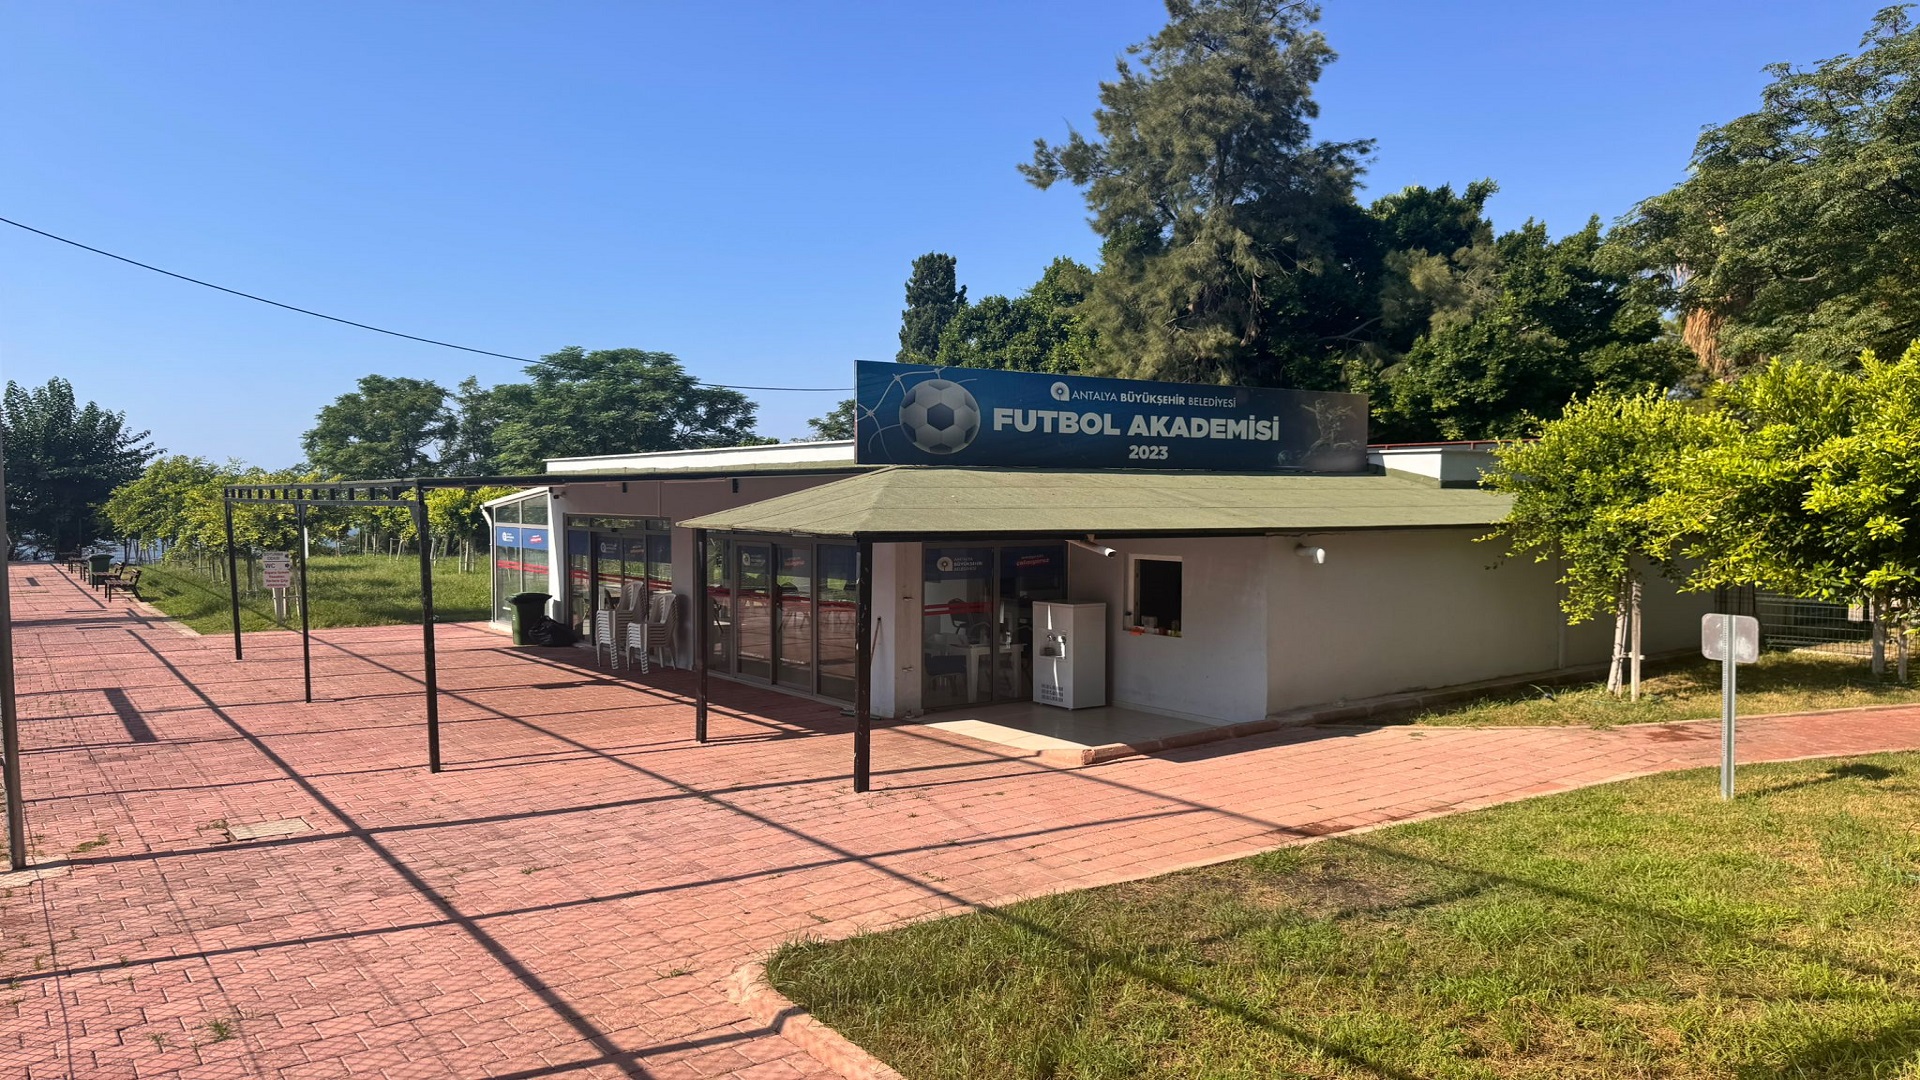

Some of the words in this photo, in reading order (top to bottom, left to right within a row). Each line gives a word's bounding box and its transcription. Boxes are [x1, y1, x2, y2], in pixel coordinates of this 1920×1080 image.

[1071, 390, 1118, 402] ANTALYA
[1120, 391, 1185, 405] BÜYÜKŞEHİR
[1188, 395, 1236, 408] BELEDİYESİ
[993, 407, 1121, 436] FUTBOL
[1127, 414, 1280, 441] AKADEMİSİ
[1128, 445, 1168, 460] 2023
